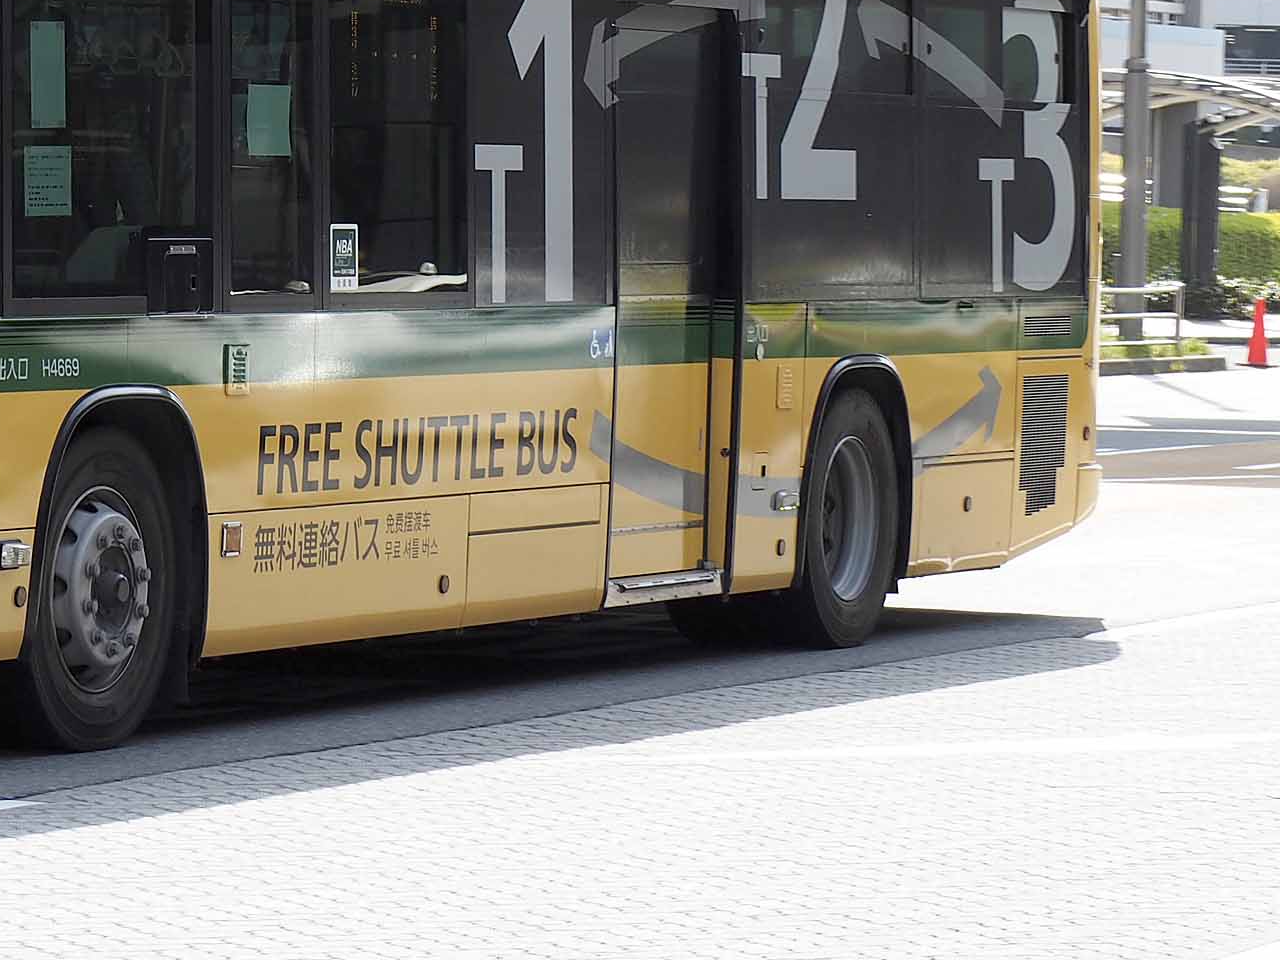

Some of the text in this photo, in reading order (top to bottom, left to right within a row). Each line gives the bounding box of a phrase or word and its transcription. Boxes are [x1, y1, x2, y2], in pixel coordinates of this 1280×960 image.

[42, 357, 80, 378] H4669
[256, 407, 578, 496] FREE SHUTTLE BUS
[253, 517, 380, 573] 無料連絡バス
[384, 539, 401, 560] 무료
